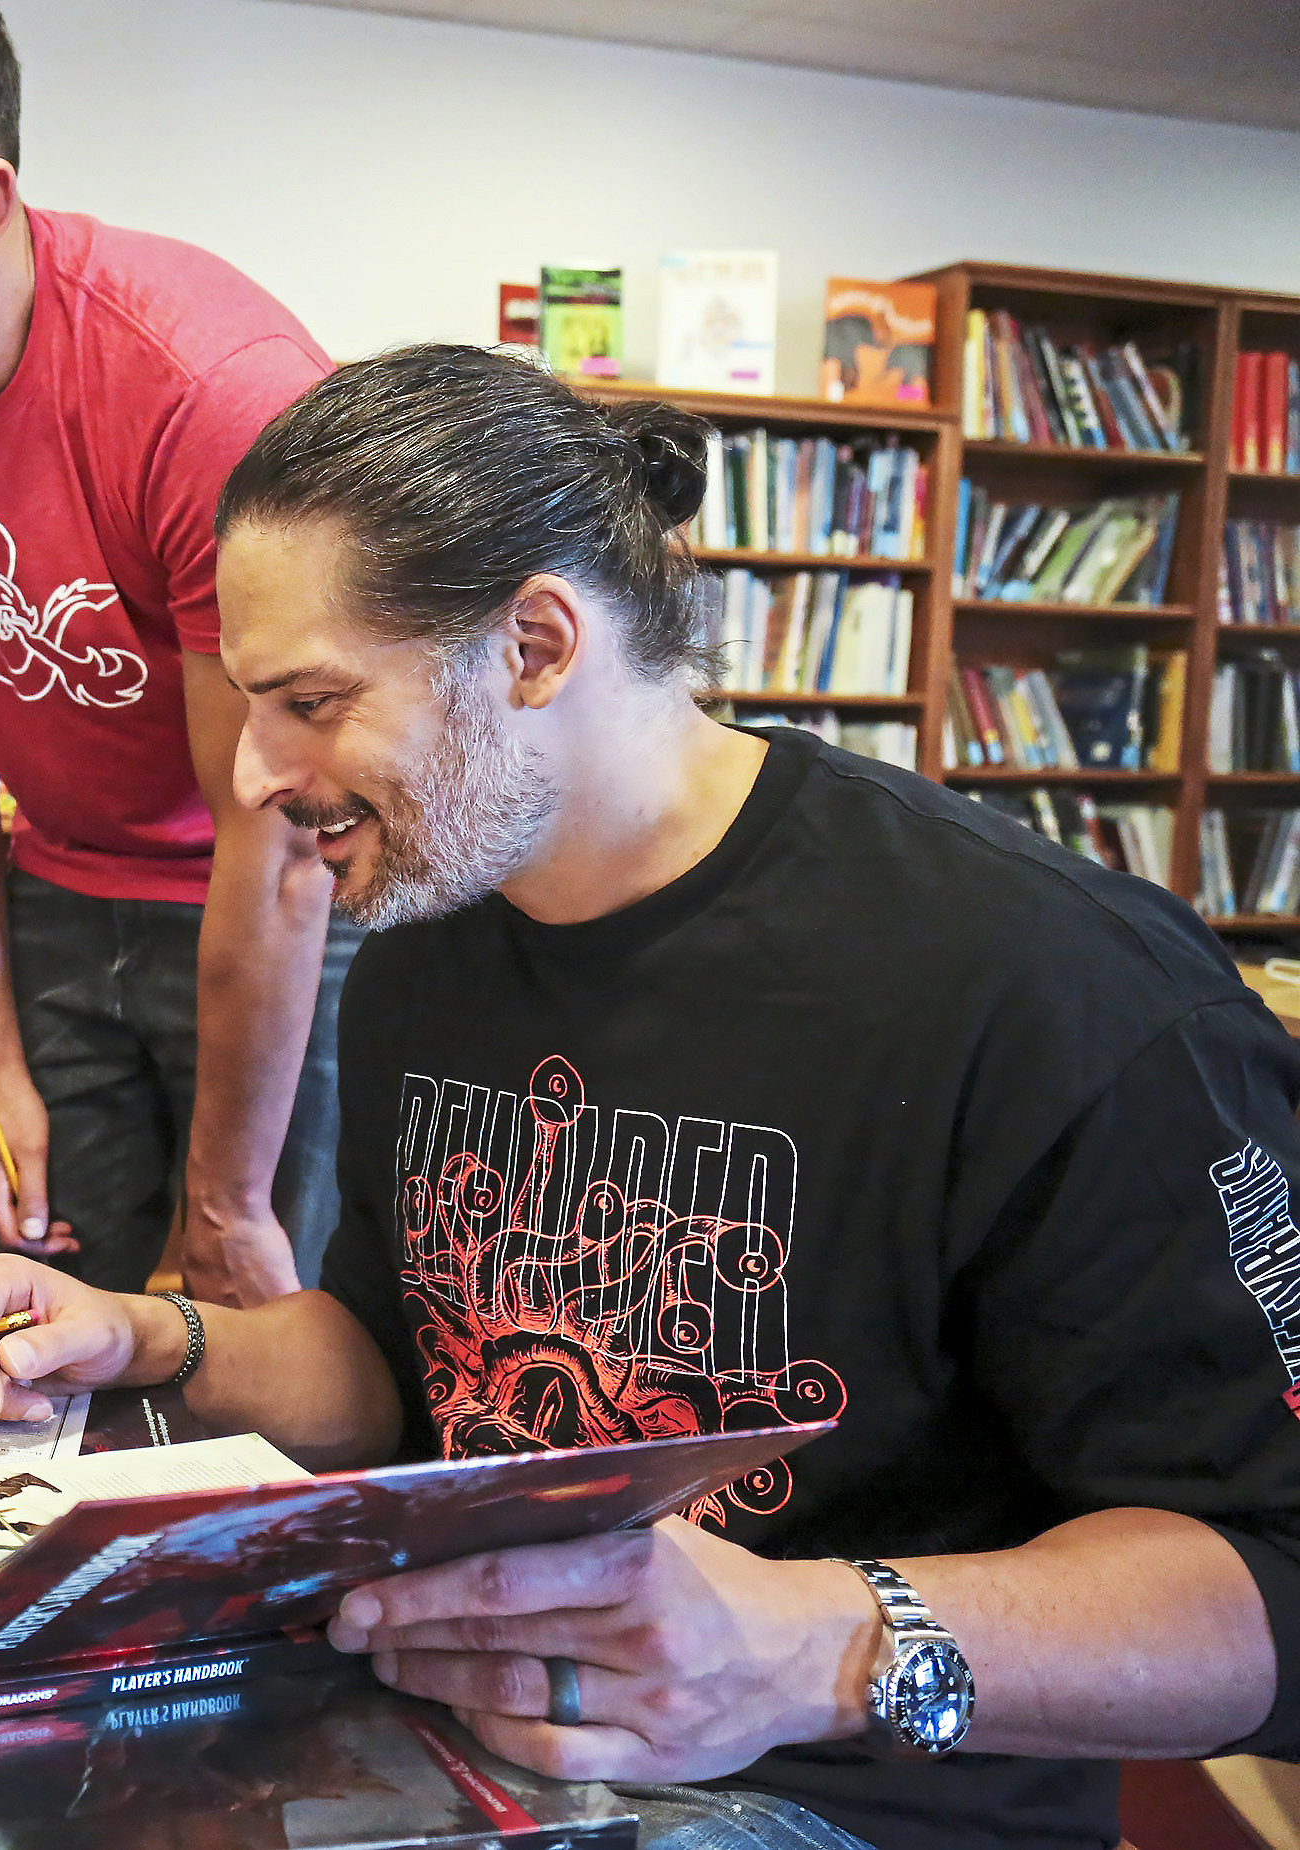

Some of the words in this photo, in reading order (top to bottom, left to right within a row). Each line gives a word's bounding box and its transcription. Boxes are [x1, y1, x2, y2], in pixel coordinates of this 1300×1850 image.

[394, 1072, 798, 1392] BEHOLDER
[111, 1669, 173, 1693] PLAYER'S
[173, 1659, 244, 1685] HANDBOOK
